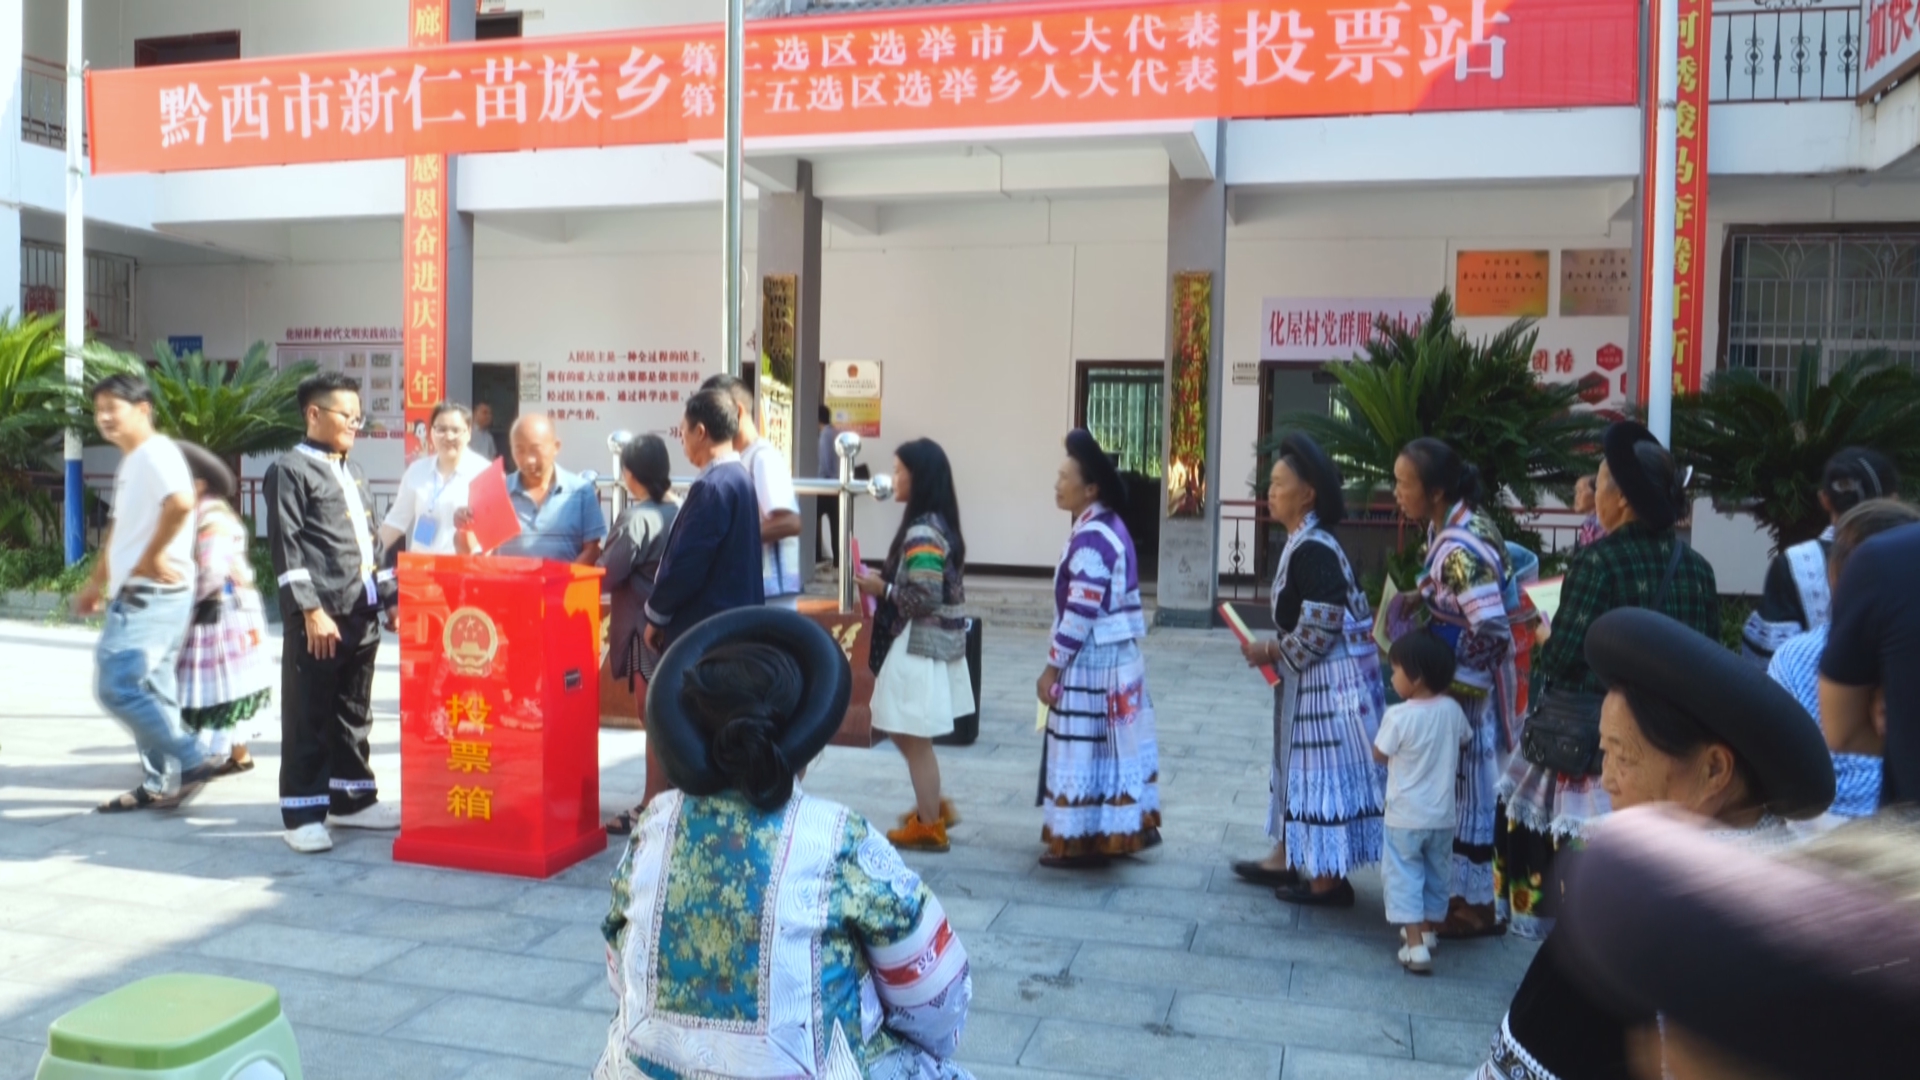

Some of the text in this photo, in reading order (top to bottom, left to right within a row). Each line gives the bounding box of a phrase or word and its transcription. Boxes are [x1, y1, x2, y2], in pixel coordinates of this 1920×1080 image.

[1232, 0, 1510, 88] 投票站
[159, 45, 671, 148] 黔西市新仁苗族乡
[446, 693, 494, 821] 投票箱
